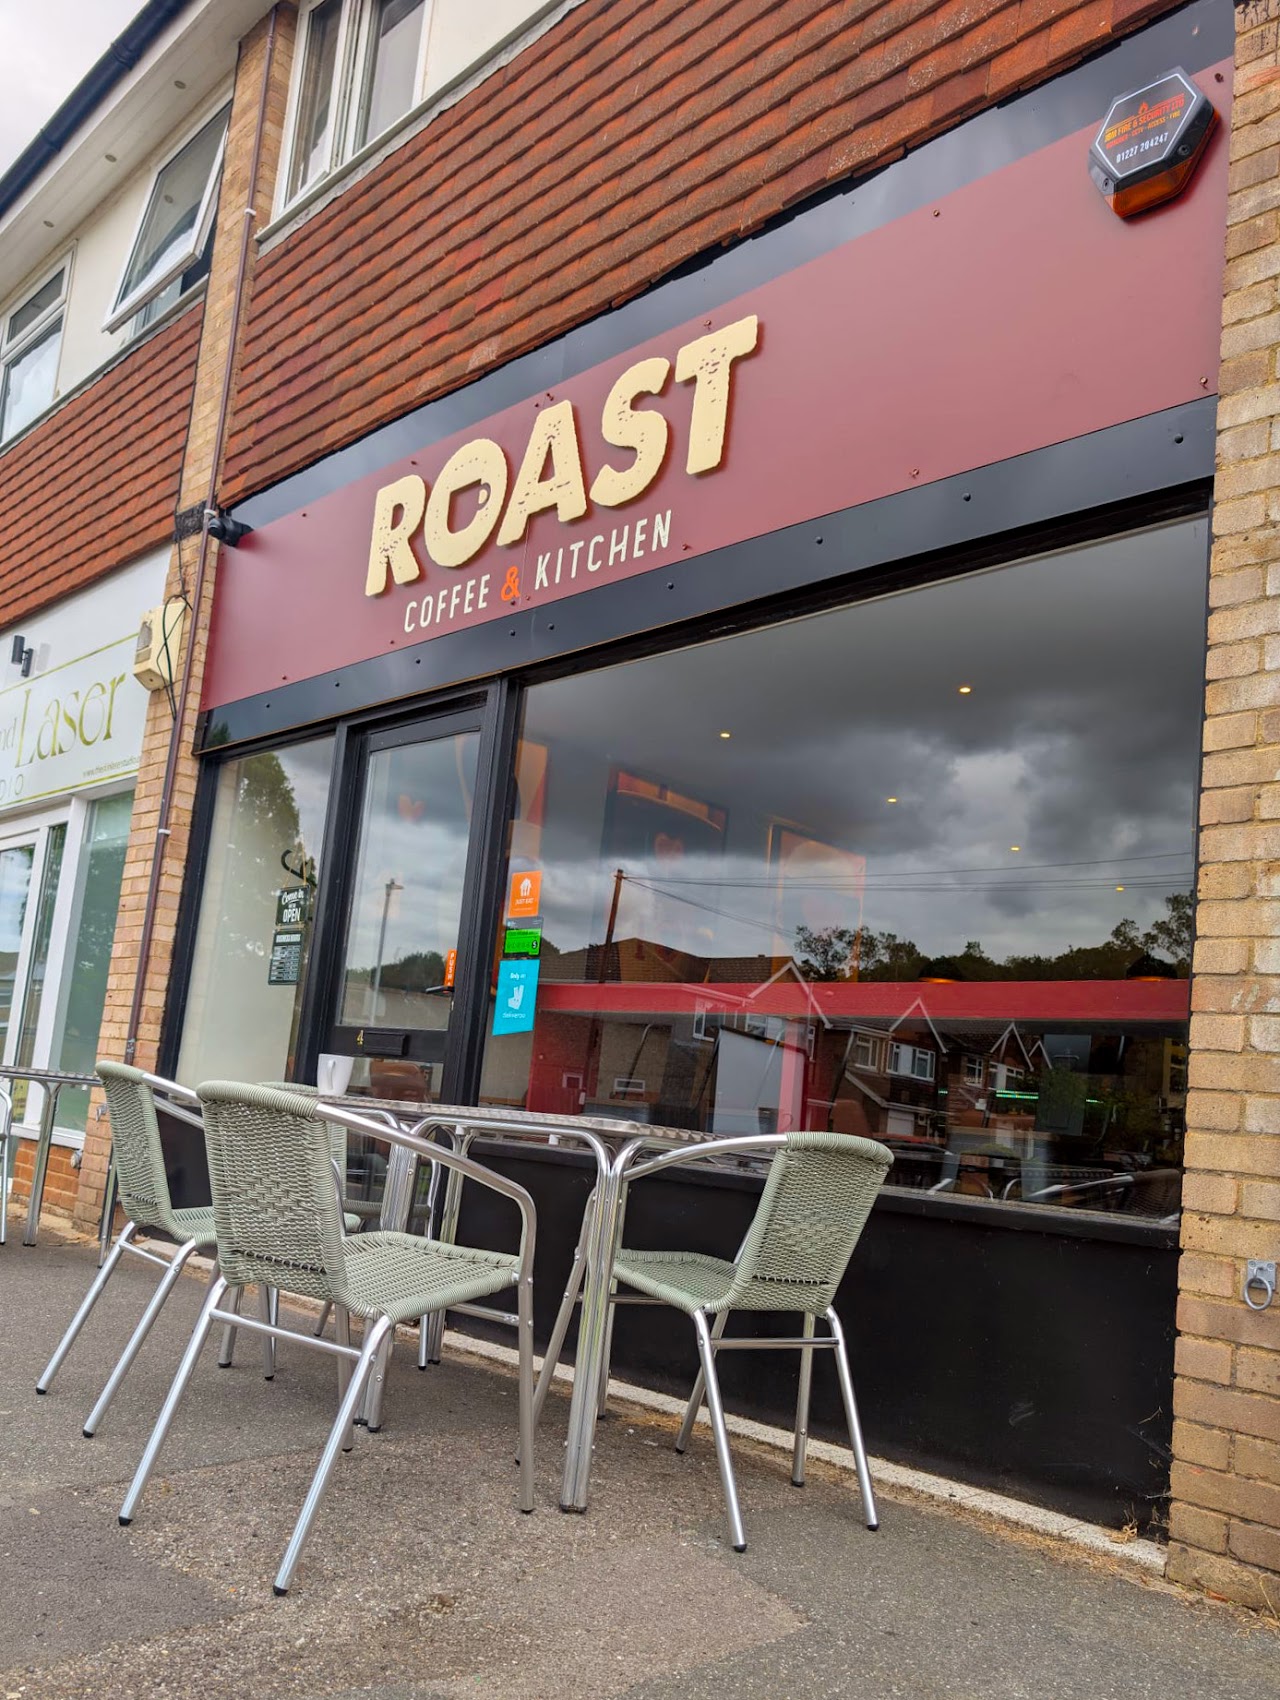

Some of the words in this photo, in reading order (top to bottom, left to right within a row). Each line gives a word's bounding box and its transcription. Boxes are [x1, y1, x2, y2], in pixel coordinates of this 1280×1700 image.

[1139, 103, 1170, 125] SECURITY
[1116, 146, 1138, 163] 01227
[365, 315, 758, 596] ROAST
[404, 574, 491, 632] COFFEE
[501, 566, 520, 601] &
[534, 510, 672, 590] KITCHEN
[15, 673, 126, 768] Laser
[283, 907, 301, 922] OPEN
[447, 952, 455, 980] PUSH
[356, 1029, 364, 1045] 4
